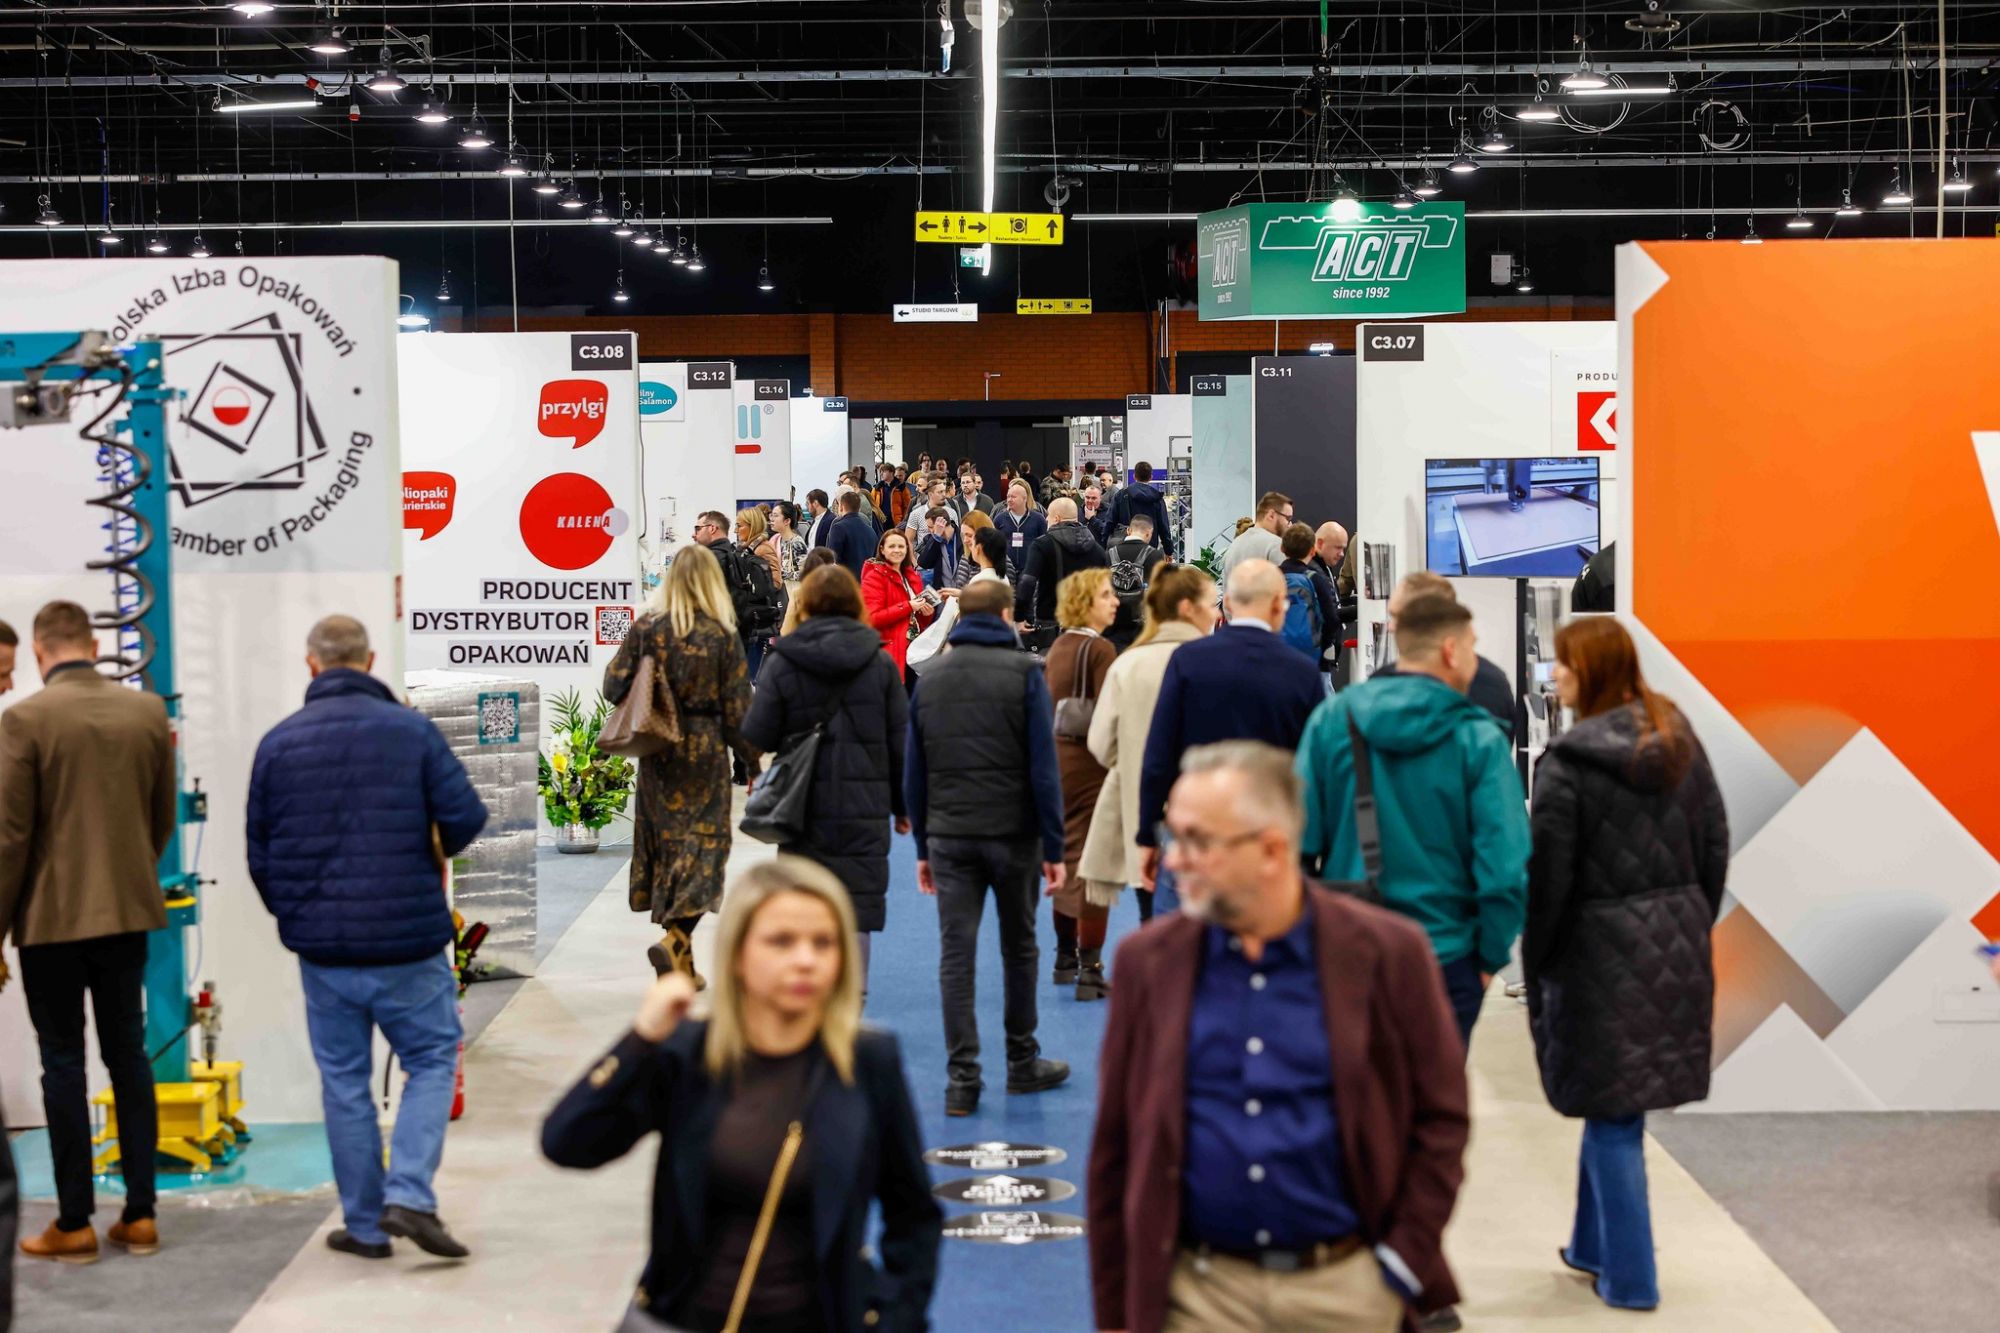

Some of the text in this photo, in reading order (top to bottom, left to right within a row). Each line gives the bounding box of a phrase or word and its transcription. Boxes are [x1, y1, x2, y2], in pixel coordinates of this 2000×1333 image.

[1318, 235, 1416, 276] ACT
[1333, 287, 1390, 299] since 1992
[112, 264, 358, 358] olska Izba Opakowań
[1371, 336, 1416, 349] C3.07
[578, 345, 625, 360] C3.08
[693, 371, 726, 382] C3.12
[1261, 367, 1293, 377] C3.11
[758, 386, 784, 394] C3.16
[1196, 382, 1222, 390] C3.15
[542, 397, 605, 420] przylgi
[171, 430, 374, 556] amber of Packaging
[483, 580, 633, 600] PRODUCENT
[412, 611, 590, 631] DYSTRYBUTOR
[449, 639, 589, 664] OPAKOWAŃ
